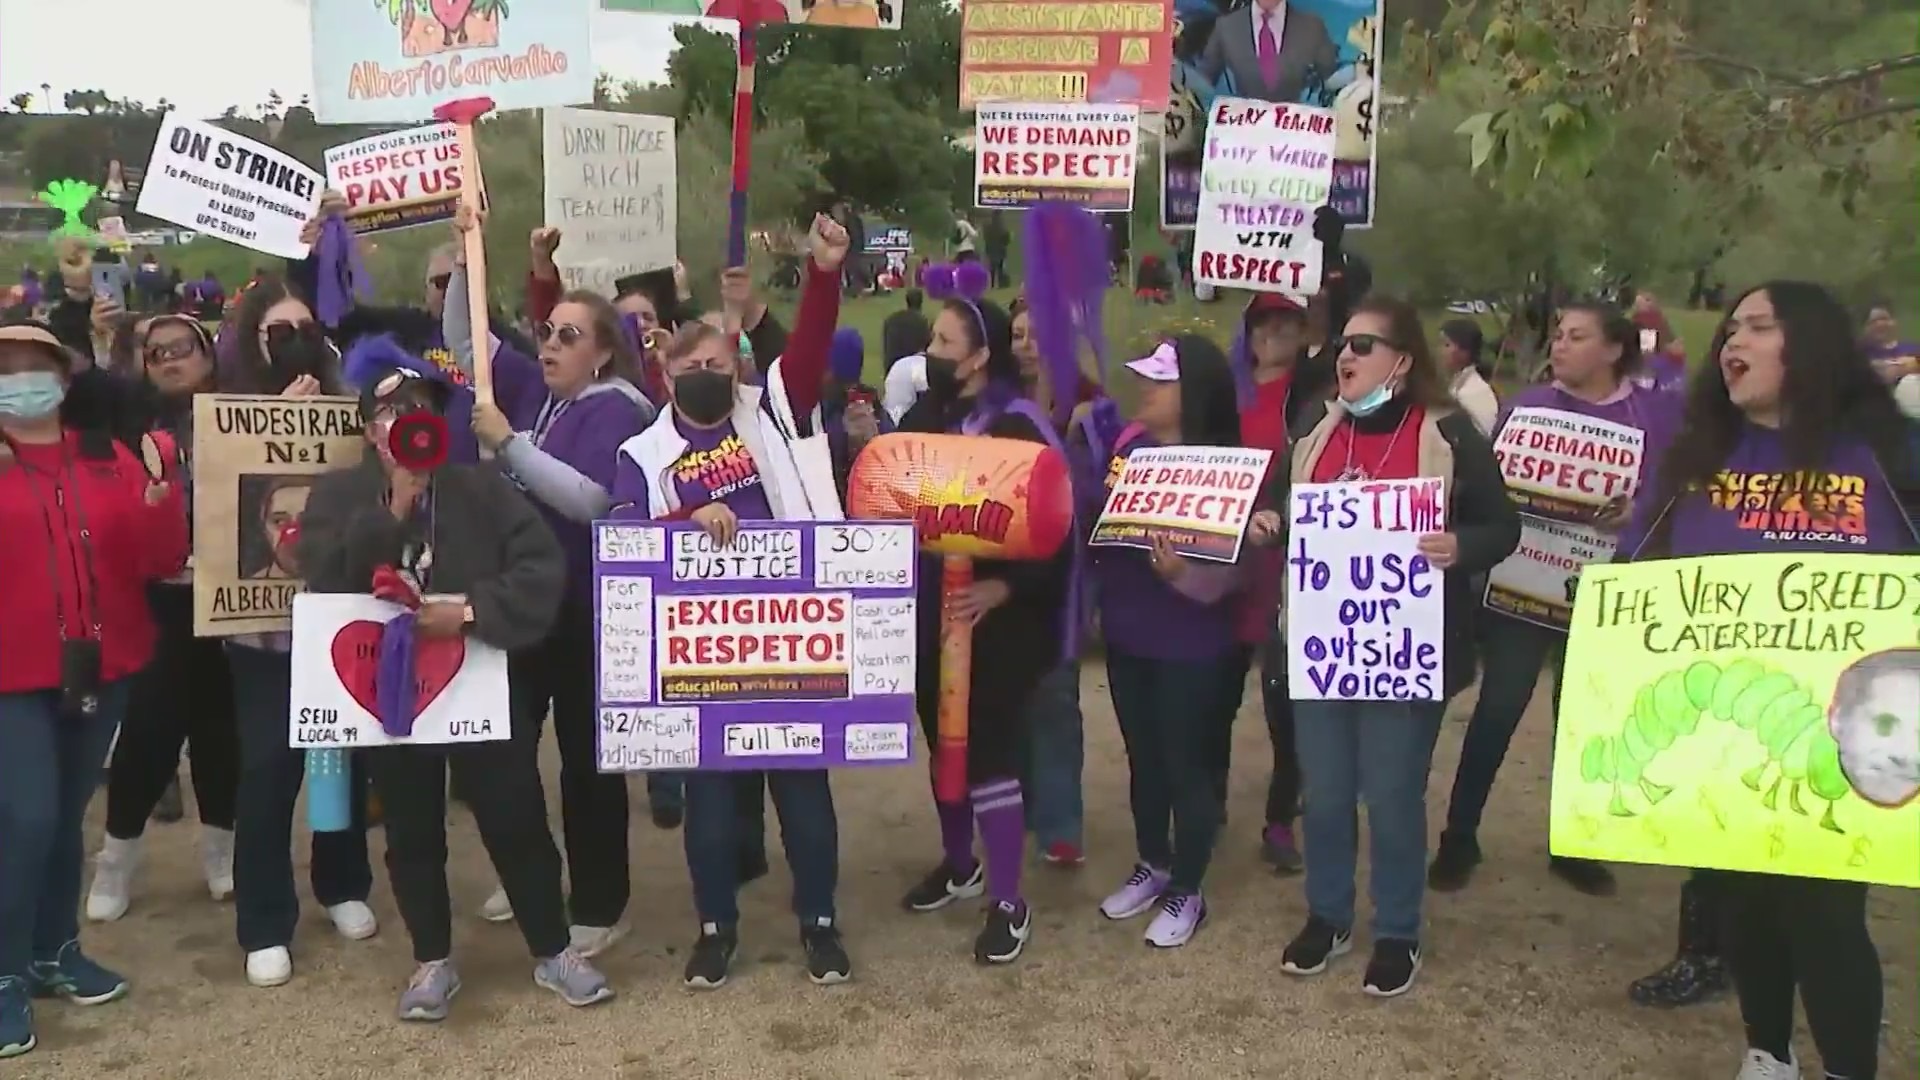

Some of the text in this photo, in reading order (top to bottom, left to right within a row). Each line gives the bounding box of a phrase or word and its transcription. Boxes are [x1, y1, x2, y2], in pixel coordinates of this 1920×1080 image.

[969, 3, 1160, 30] ASSISTANTS
[970, 38, 1147, 64] DESERVE A
[348, 44, 568, 99] Alberto Carvalho
[969, 74, 1085, 99] RAISE!!!
[979, 111, 1136, 123] WE'RE ESSENTIAL EVERY DAY
[329, 130, 457, 163] WE FEED OUR STUDEN
[563, 126, 605, 156] DARN
[983, 126, 1131, 146] WE DEMAND
[170, 126, 315, 201] ON STRIKE!
[338, 149, 427, 180] RESPECT
[583, 159, 639, 188] RICH
[982, 151, 1131, 177] RESPECT!
[179, 170, 220, 191] Protest
[256, 195, 307, 221] Practices
[346, 175, 408, 206] PAY
[1218, 203, 1305, 228] TREATED
[1237, 232, 1293, 249] WITH
[1200, 251, 1306, 289] RESPECT
[1581, 421, 1616, 439] EVERY
[1618, 433, 1641, 446] DAY
[1502, 427, 1635, 468] WE DEMAND
[1208, 456, 1240, 466] EVERY
[1241, 457, 1266, 467] DAY
[1124, 468, 1153, 485] WE
[1155, 468, 1255, 491] DEMAND
[1109, 491, 1248, 524] RESPECT!
[1296, 481, 1442, 533] It's TIME
[607, 543, 657, 558] STAFF
[1798, 532, 1845, 542] LOCAL
[1849, 535, 1868, 545] 99
[676, 556, 798, 579] JUSTICE
[1290, 538, 1432, 598] to use
[1519, 545, 1583, 572] XIGIMOS
[820, 561, 908, 585] Increase
[606, 580, 639, 597] For
[1592, 577, 1658, 627] THE
[1676, 566, 1751, 618] VERY
[1778, 562, 1920, 615] GREED
[668, 597, 844, 631] ¡EXIGIMOS
[1339, 598, 1400, 625] our
[1644, 616, 1866, 653] CATERPILLAR
[612, 656, 636, 667] and
[669, 633, 844, 664] RESPETO!
[856, 654, 911, 668] Vacation
[1303, 627, 1437, 671] outside
[665, 679, 739, 694] education
[741, 678, 799, 691] workers
[864, 674, 900, 692] Pay
[1307, 663, 1433, 700] Voices
[299, 707, 338, 724] SEIU
[450, 719, 492, 736] UTLA
[298, 727, 358, 743] LOCAL 99
[728, 725, 821, 751] Full Time
